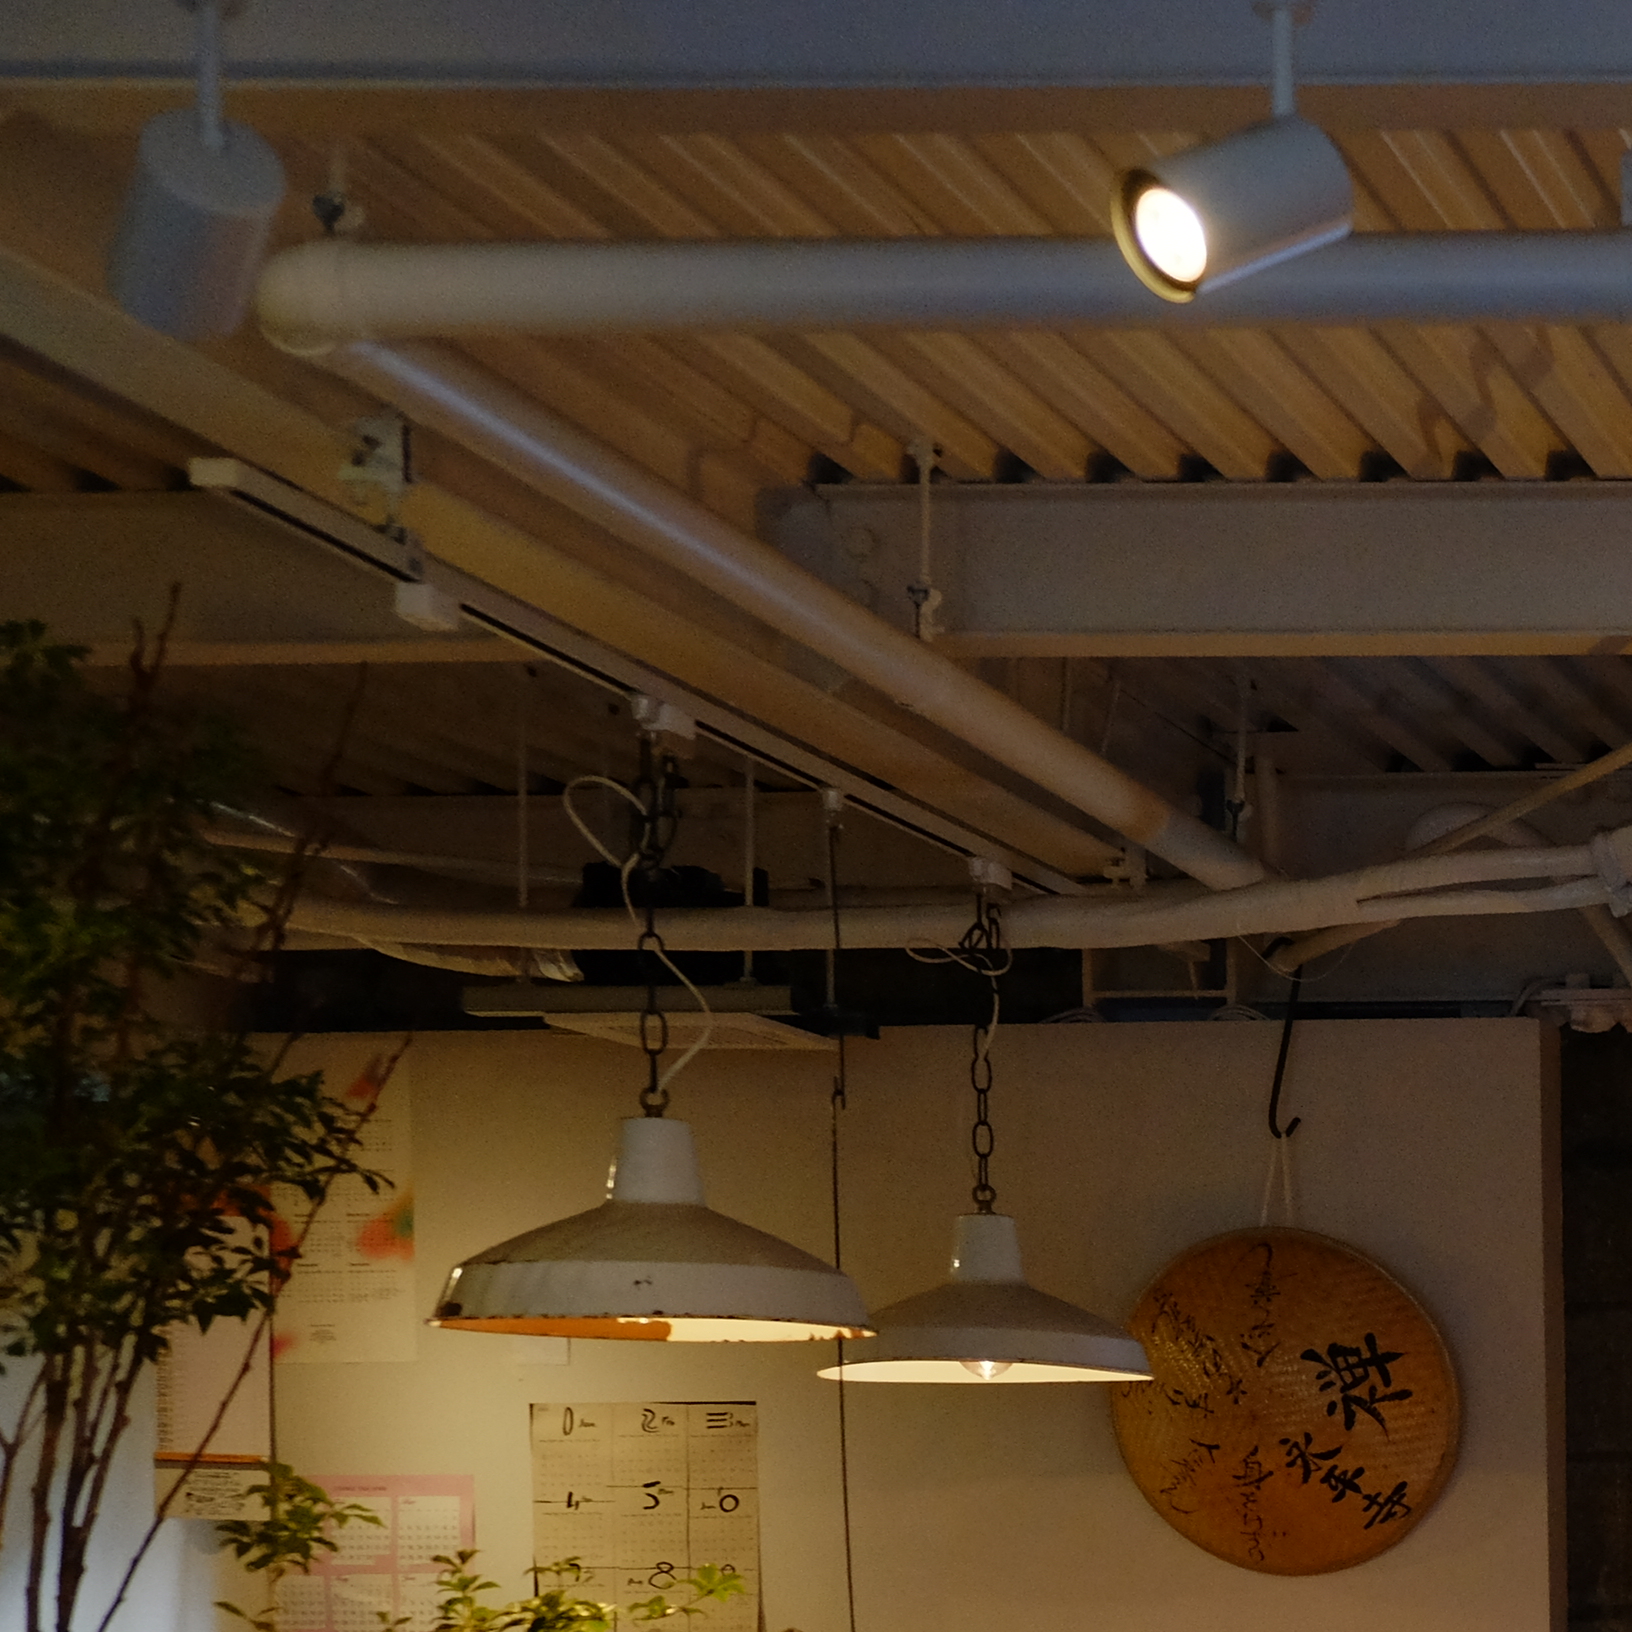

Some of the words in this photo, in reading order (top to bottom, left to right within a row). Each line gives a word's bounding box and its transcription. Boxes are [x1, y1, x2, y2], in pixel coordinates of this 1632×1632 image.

[1300, 1332, 1409, 1441] 禅
[1278, 1431, 1412, 1530] 永平寺
